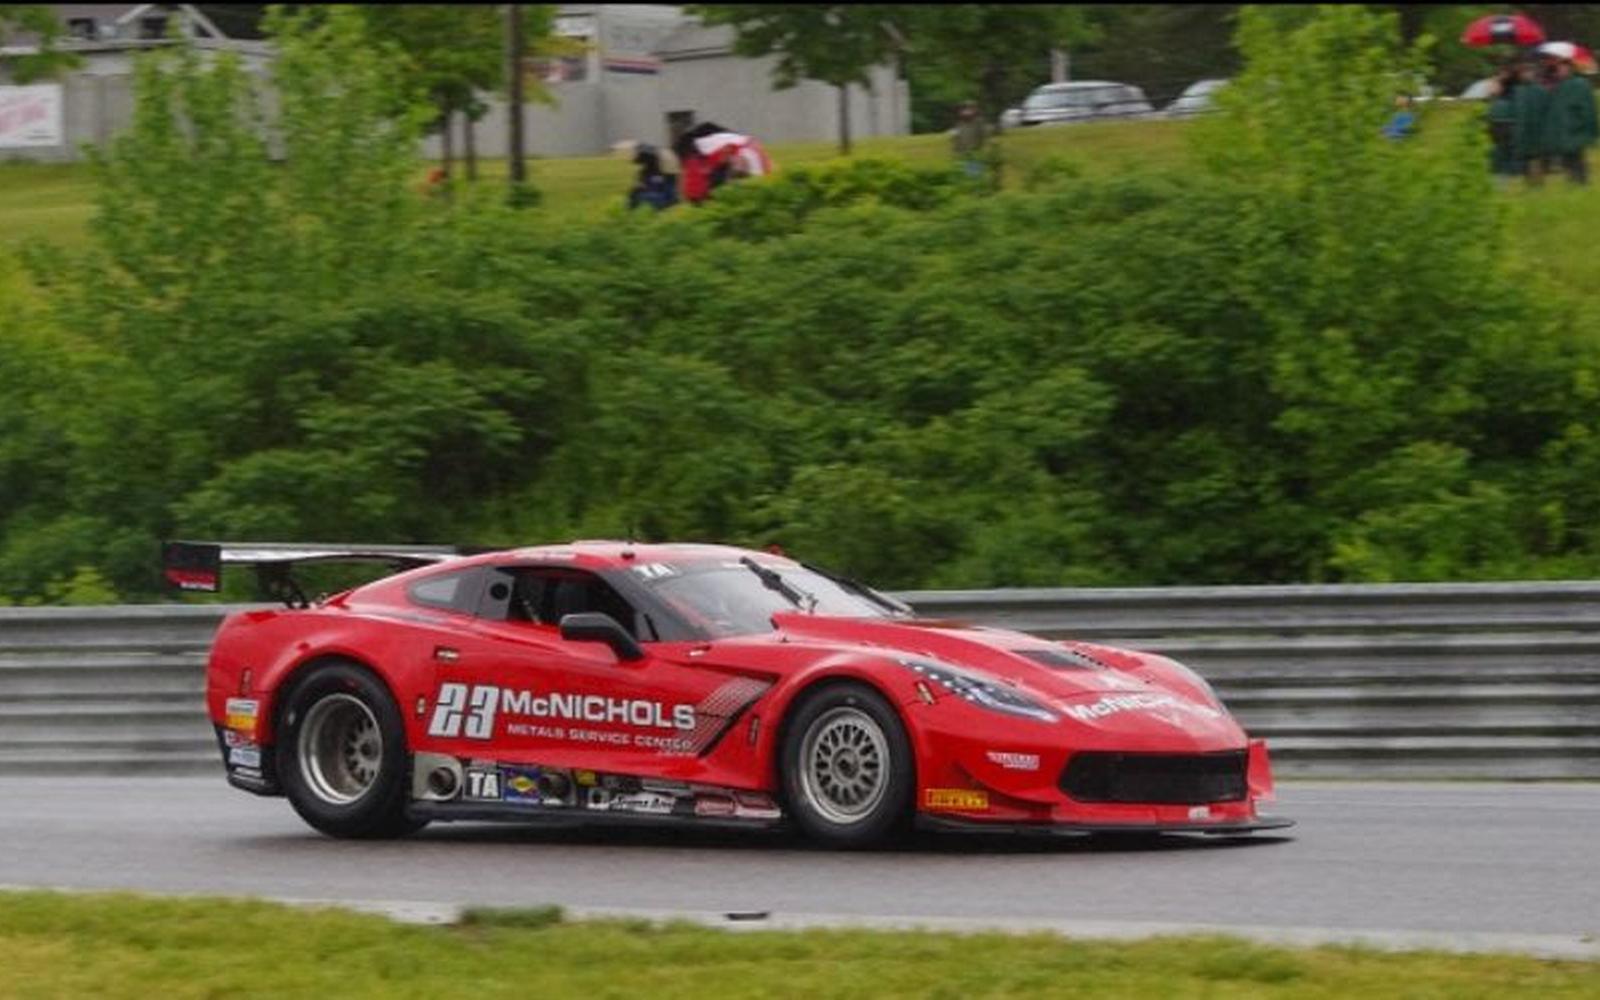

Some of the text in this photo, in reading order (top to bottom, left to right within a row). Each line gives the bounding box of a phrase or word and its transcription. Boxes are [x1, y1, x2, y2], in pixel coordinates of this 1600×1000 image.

[428, 683, 697, 739] 23 McNICHOLS
[507, 723, 694, 749] METALS SERVICE CENTER
[468, 772, 499, 797] TA
